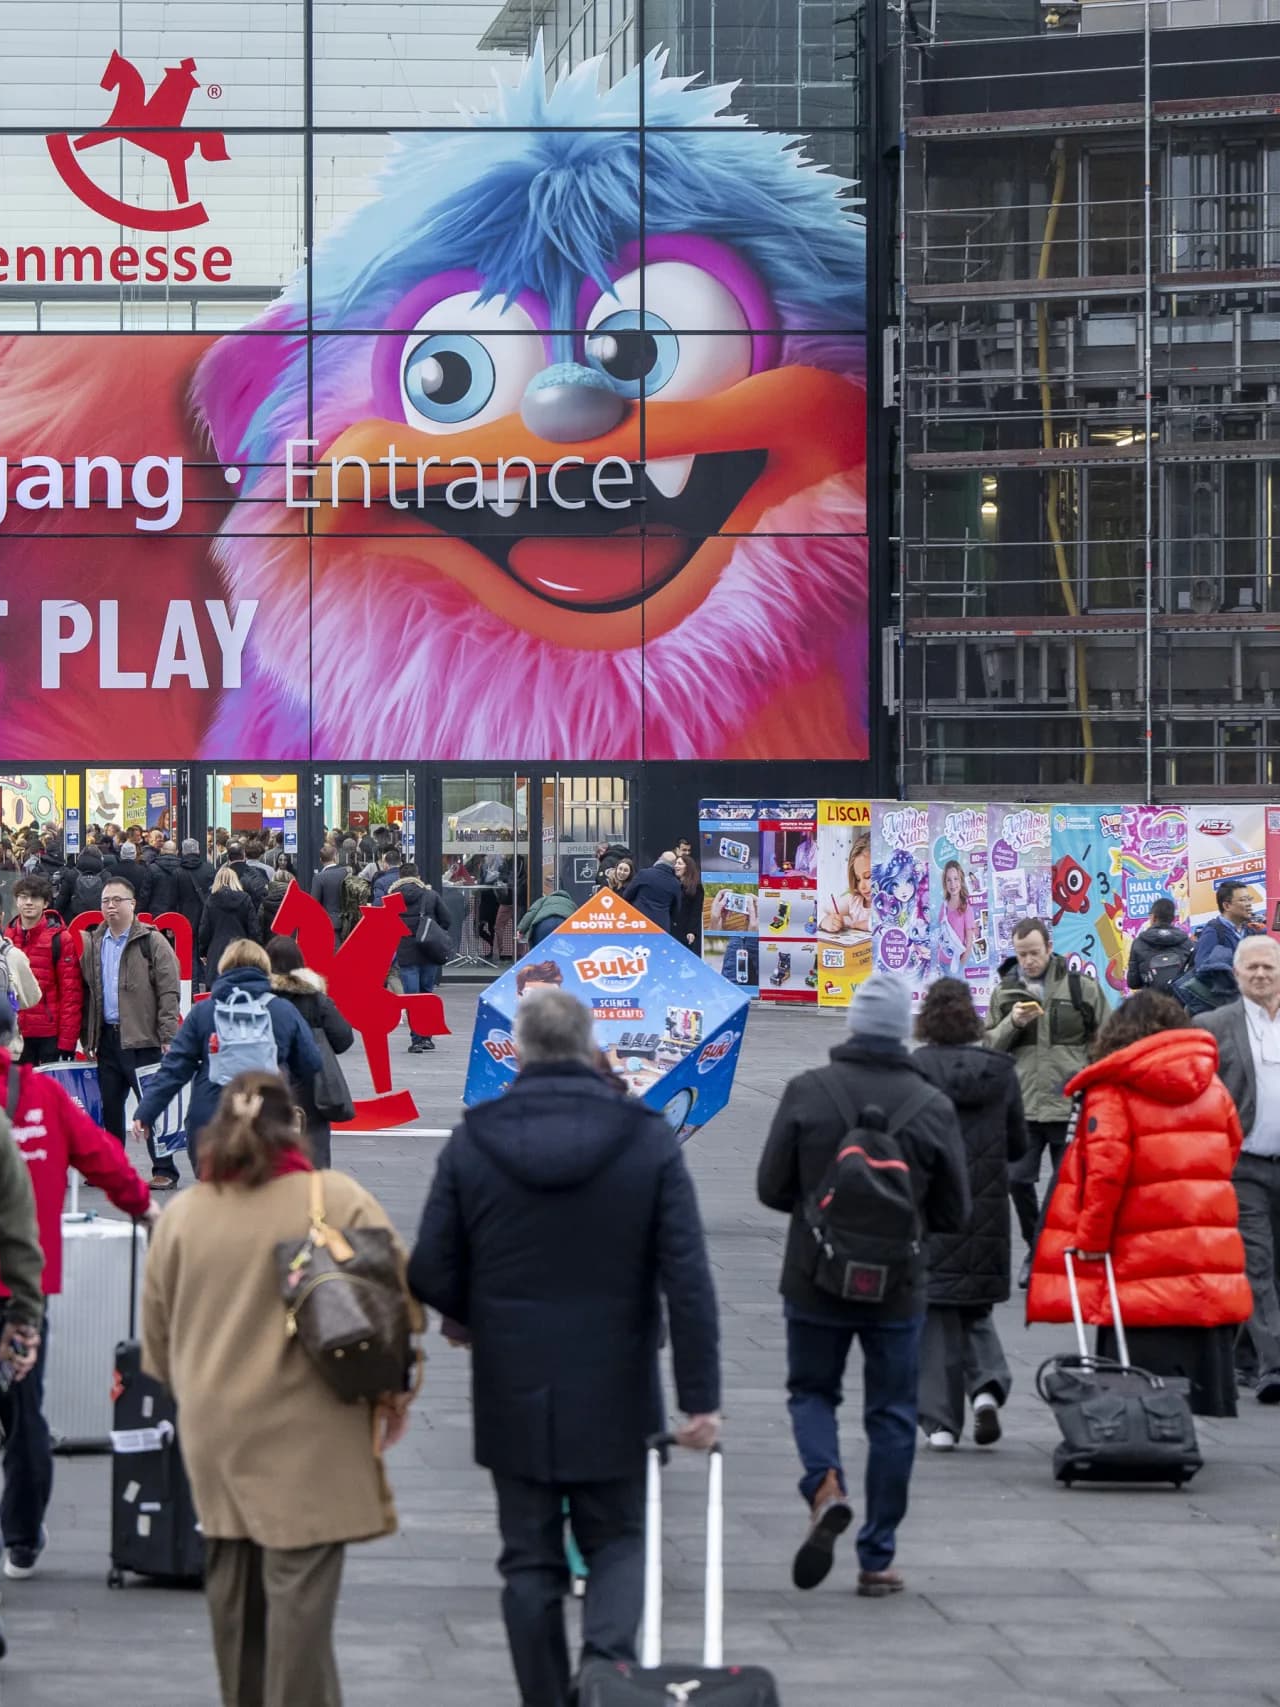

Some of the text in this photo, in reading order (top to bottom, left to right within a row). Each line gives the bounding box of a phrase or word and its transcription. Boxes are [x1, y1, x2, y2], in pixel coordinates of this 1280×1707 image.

[287, 439, 633, 511] Entrance
[41, 599, 259, 689] PLAY
[1198, 819, 1232, 829] MSZ
[1129, 882, 1162, 892] HALL 6
[1130, 893, 1162, 905] STAND
[589, 912, 627, 920] HALL 4
[571, 921, 613, 929] BOOTH
[1081, 934, 1095, 957] 2
[825, 954, 842, 966] PEN
[576, 957, 645, 981] Buki
[599, 999, 632, 1007] SCIENCE
[593, 1009, 607, 1018] RTS
[616, 1009, 644, 1018] CRAFTS
